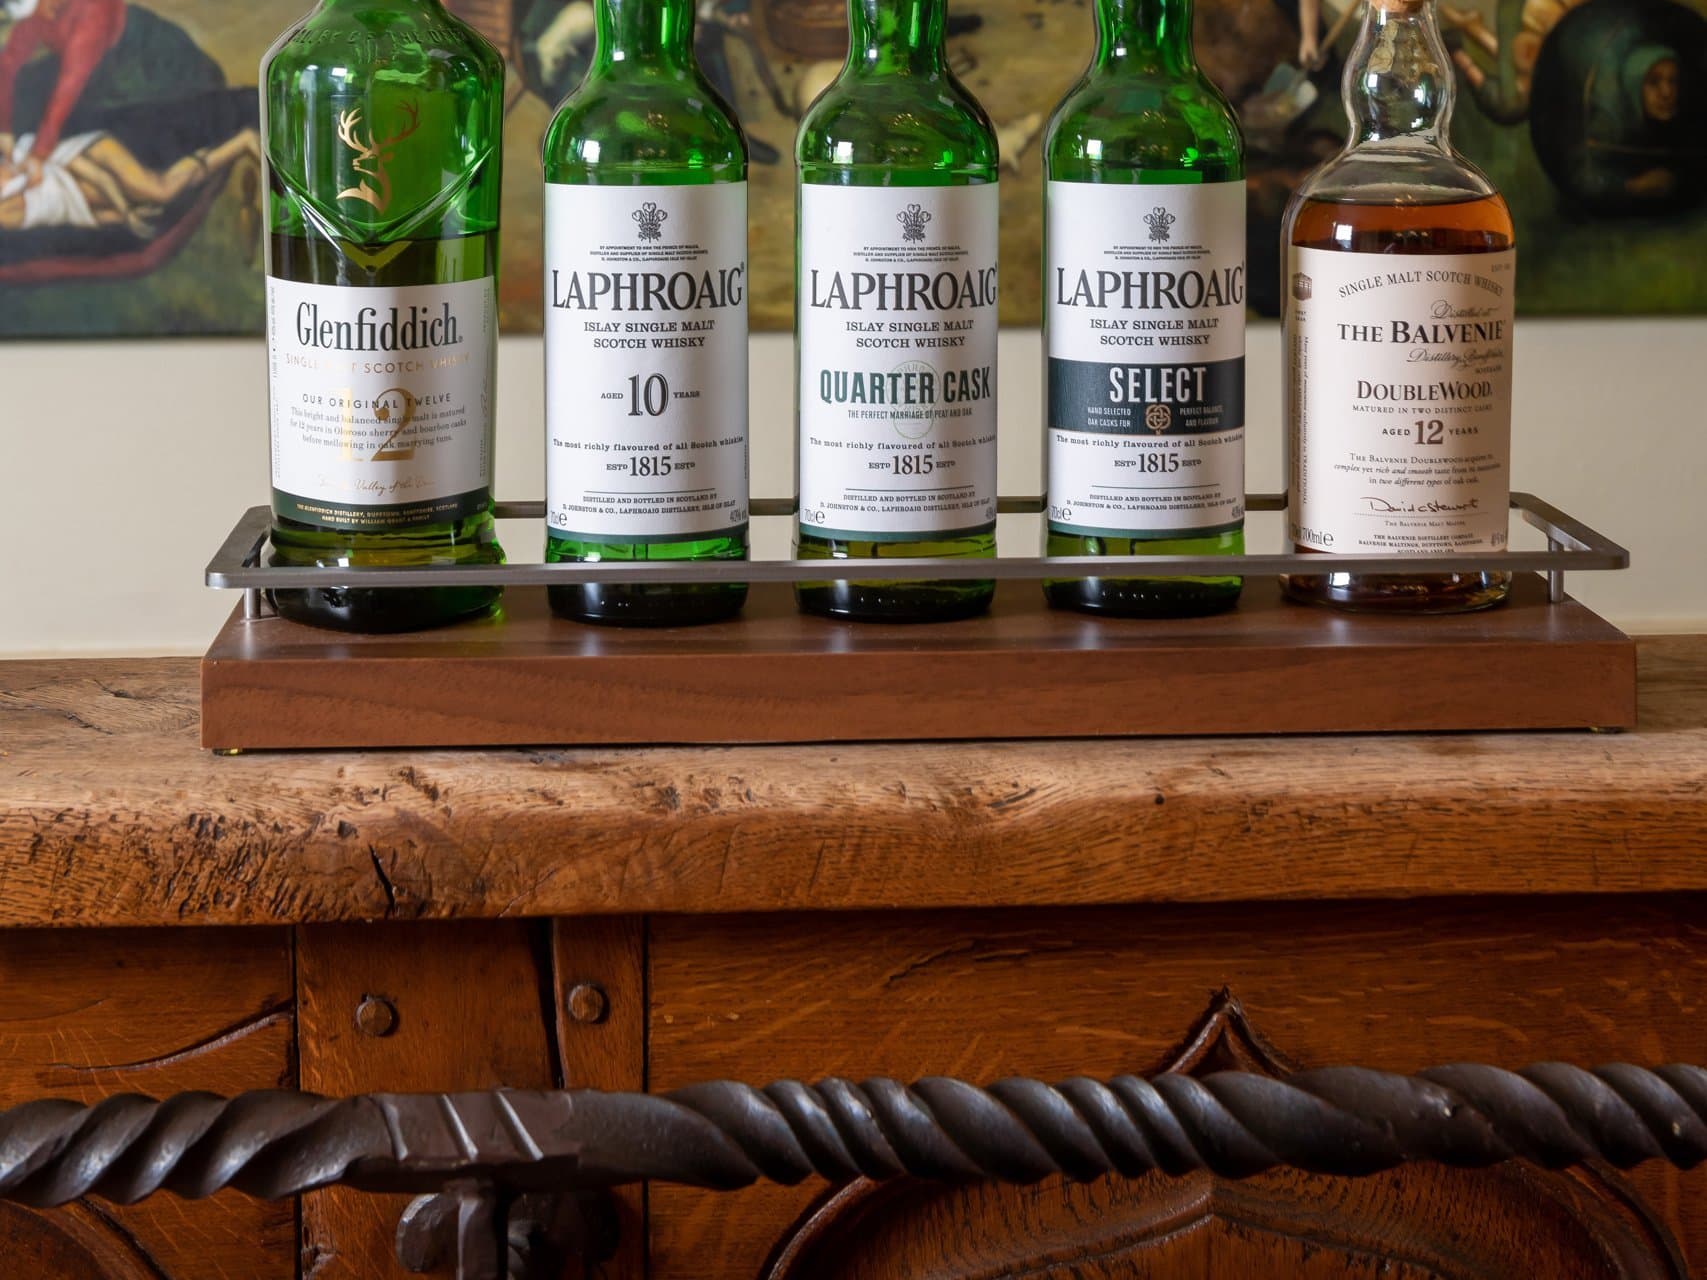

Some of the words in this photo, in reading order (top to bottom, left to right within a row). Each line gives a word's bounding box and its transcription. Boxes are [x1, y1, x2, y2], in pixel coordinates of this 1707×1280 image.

[552, 269, 742, 311] LAPHROAIG
[811, 269, 996, 311] LAPHROAIG
[1057, 267, 1243, 309] LAPHROAIG
[1338, 276, 1383, 298] SINGLE
[1387, 271, 1422, 284] MALT
[1426, 271, 1471, 284] SCOTCH
[584, 321, 621, 332] ISLAY
[625, 322, 677, 332] SINGLE
[682, 320, 715, 332] MALT
[846, 321, 884, 332] ISLAY
[889, 321, 939, 332] SINGLE
[943, 320, 974, 331] MALT
[1090, 319, 1128, 329] ISLAY
[1132, 319, 1183, 330] SINGLE
[1188, 318, 1219, 329] MALT
[1337, 323, 1383, 343] THE
[1390, 320, 1503, 344] BALVENIE
[593, 338, 646, 348] SCOTCH
[651, 336, 705, 348] WHISKY
[856, 338, 910, 348] SCOTCH
[915, 336, 965, 347] WHISKY
[1100, 335, 1153, 346] SCOTCH
[1159, 334, 1210, 345] WHISKY
[364, 362, 423, 374] SCOTCH
[820, 369, 935, 405] QUARTER
[943, 367, 991, 403] CASK
[1109, 367, 1207, 403] SELECT
[302, 394, 322, 405] OUR
[329, 398, 398, 408] ORIGINAL
[407, 393, 452, 406] TWELVE
[627, 373, 669, 416] 10
[674, 391, 700, 399] YEARS
[848, 409, 859, 418] THE
[861, 410, 888, 419] PERFECT
[890, 410, 924, 419] MARRIAGE
[926, 410, 933, 419] OF
[934, 409, 948, 418] PEAT
[950, 408, 961, 417] AND
[962, 407, 972, 416] OAK
[1087, 407, 1102, 415] HAND
[1103, 407, 1131, 416] SELECTED
[1352, 405, 1394, 414] MATURED
[1398, 406, 1408, 414] IN
[1434, 405, 1472, 414] DISTINCT
[326, 413, 340, 422] and
[1088, 418, 1099, 426] OAK
[1100, 419, 1118, 427] CASKS
[1120, 419, 1131, 427] FOR
[325, 426, 332, 434] in
[369, 427, 398, 437] sherr
[1382, 428, 1410, 436] AGED
[1414, 419, 1444, 445] 12
[1449, 427, 1479, 435] YEARS
[366, 439, 375, 449] in
[565, 441, 581, 449] most
[584, 443, 610, 451] richly
[614, 443, 659, 451] flavoured
[676, 442, 687, 450] all
[810, 437, 821, 446] The
[824, 440, 842, 448] most
[847, 442, 874, 451] richly
[877, 442, 923, 450] flavoured
[927, 441, 936, 449] of
[939, 441, 950, 449] all
[1057, 435, 1066, 443] The
[1070, 437, 1089, 446] most
[1092, 439, 1119, 448] richly
[1123, 440, 1169, 448] flavoured
[1172, 440, 1181, 448] of
[1184, 439, 1196, 447] all
[892, 454, 933, 475] 1815
[1138, 453, 1179, 473] 1815
[1369, 454, 1408, 464] BALVENIE
[629, 456, 672, 476] 1815
[1334, 463, 1360, 474] complex
[1362, 465, 1373, 474] yet
[1376, 465, 1389, 474] rich
[1369, 476, 1376, 484] in
[1379, 477, 1392, 485] two
[1394, 476, 1425, 488] different
[583, 495, 615, 503] DISTILLED
[676, 494, 708, 503] SCOTLAND
[843, 493, 877, 502] DISTILLED
[1089, 494, 1123, 502] DISTILLED
[826, 503, 859, 511] JOHNSTON
[881, 504, 921, 512] LAPHROAIG
[1127, 503, 1167, 511] LAPHROAIG
